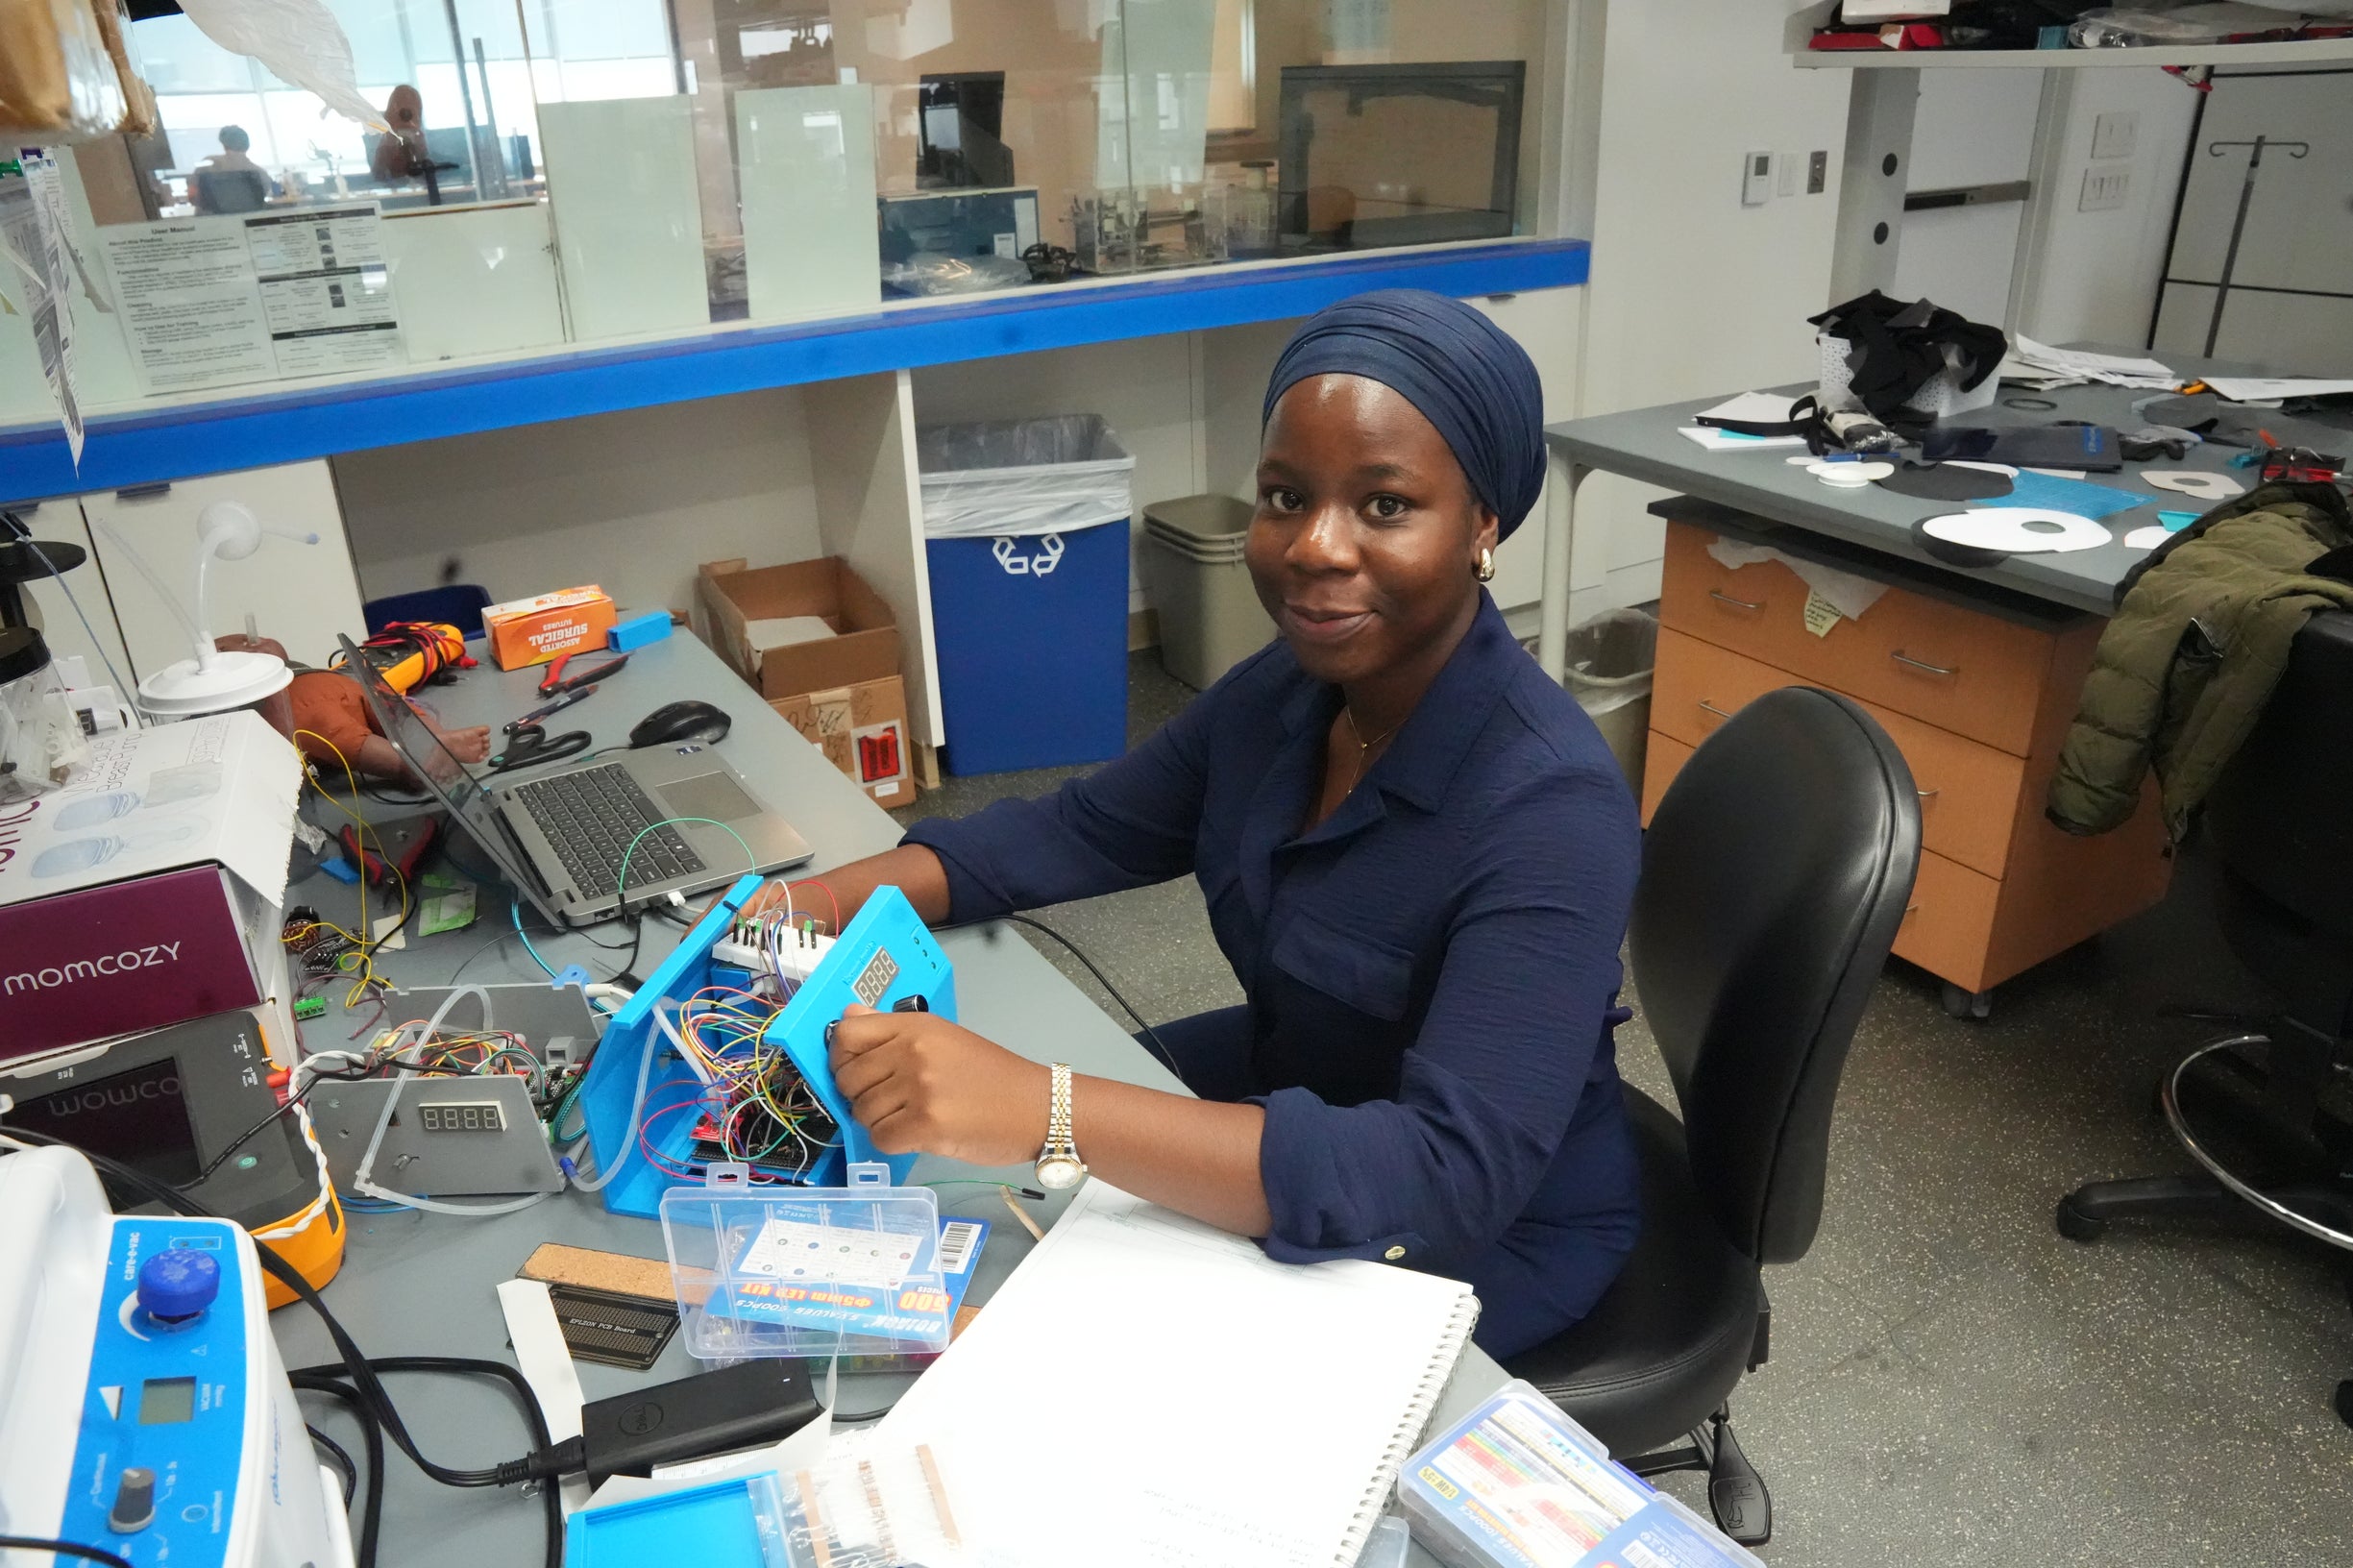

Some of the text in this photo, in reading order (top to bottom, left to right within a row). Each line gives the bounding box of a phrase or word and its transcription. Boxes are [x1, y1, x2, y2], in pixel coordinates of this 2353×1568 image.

[528, 623, 588, 646] SURGICAL
[543, 619, 573, 631] SUTURES
[540, 637, 580, 652] ASSORTED
[96, 756, 133, 793] Breast
[124, 1232, 140, 1281] care-e-vac
[739, 1283, 772, 1295] KIT
[898, 1289, 952, 1313] 500
[570, 1318, 597, 1327] EPLZON
[1435, 1481, 1458, 1498] 1/4W
[1458, 1505, 1499, 1537] 1000PCS
